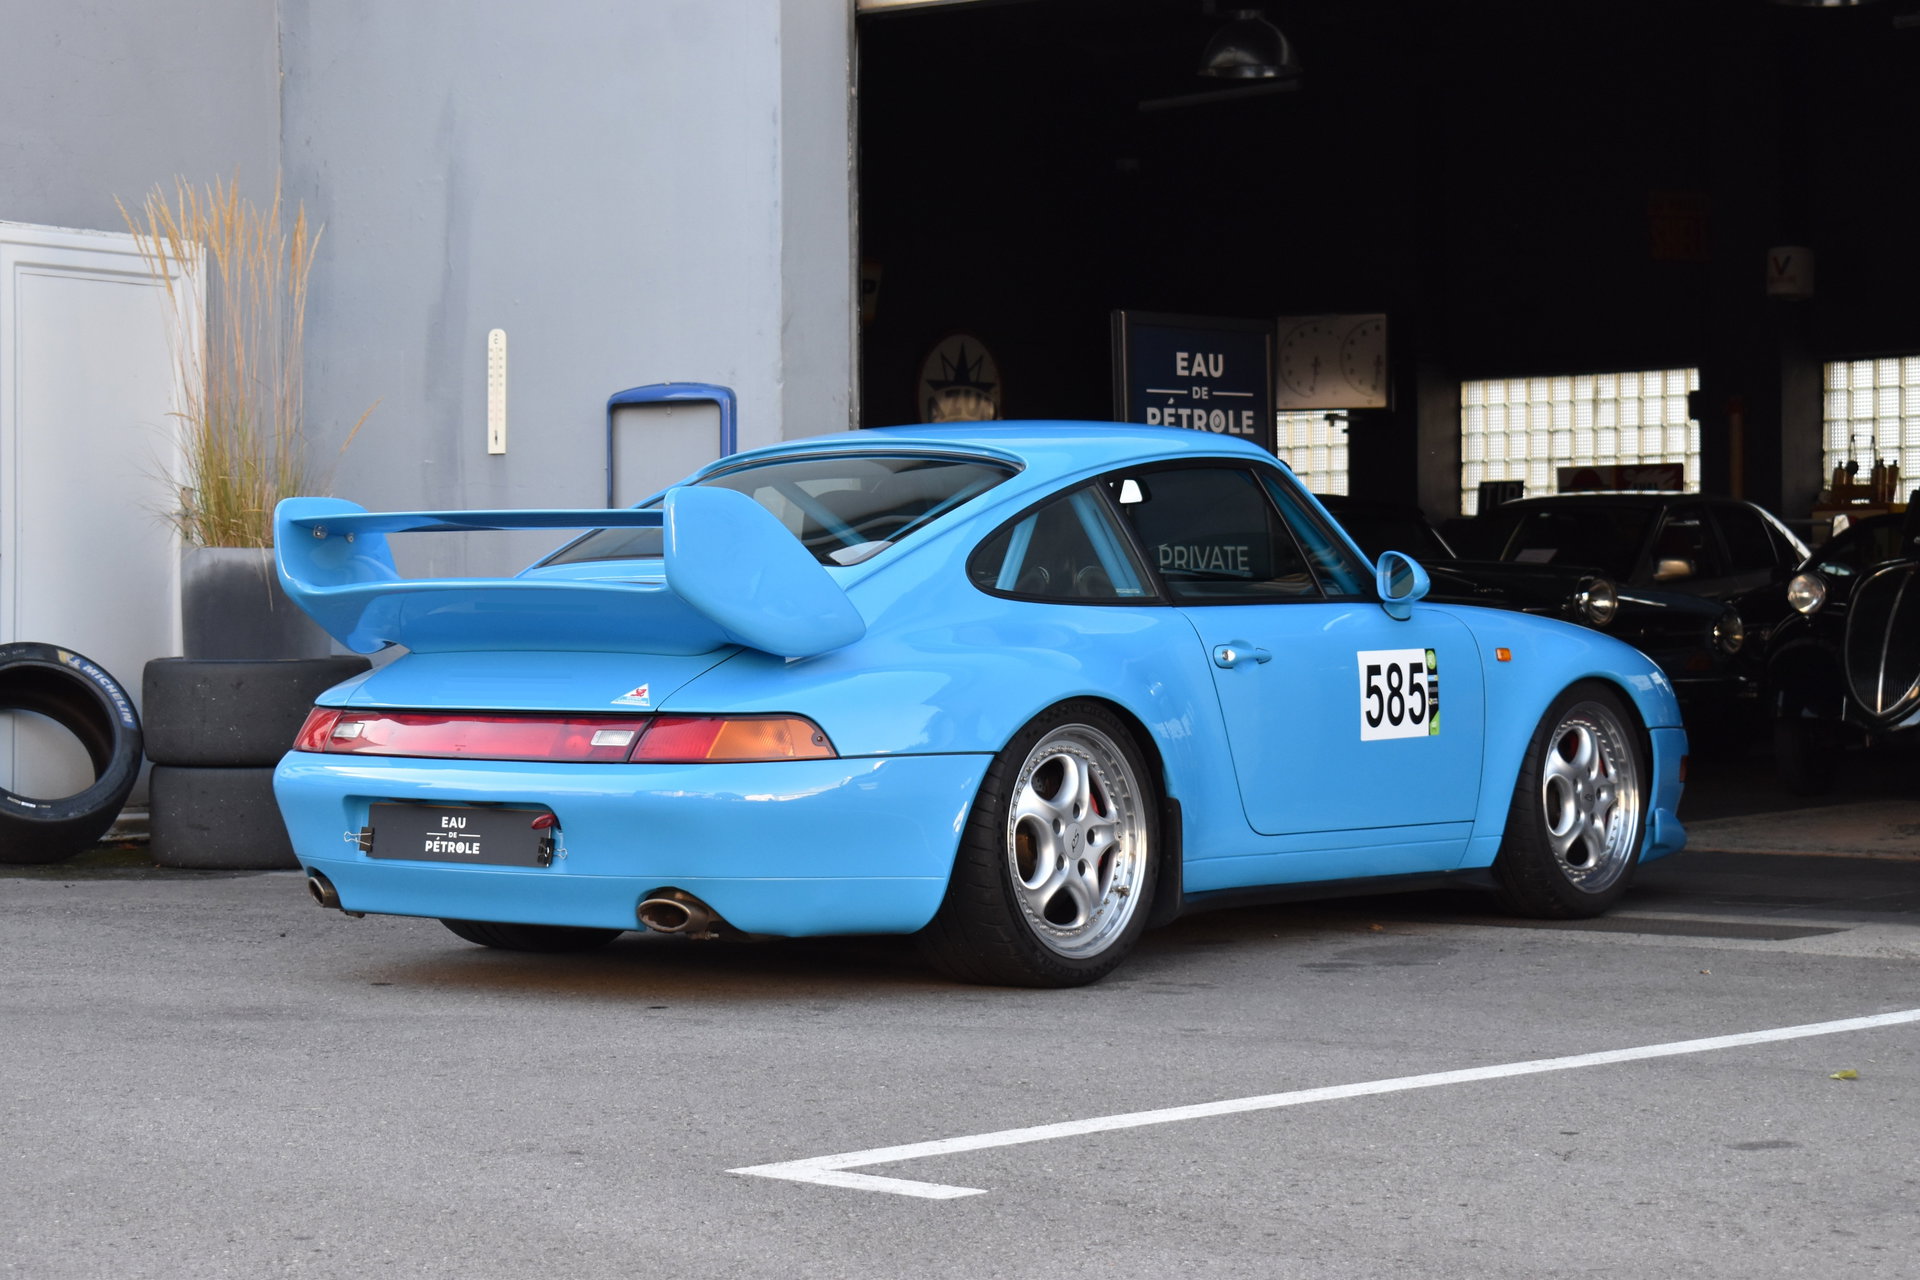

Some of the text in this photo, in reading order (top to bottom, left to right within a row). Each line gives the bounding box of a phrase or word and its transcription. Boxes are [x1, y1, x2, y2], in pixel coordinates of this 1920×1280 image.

[1175, 351, 1225, 378] EAU
[1191, 386, 1209, 400] DE
[1146, 397, 1255, 435] PÉTROLE
[1158, 543, 1250, 571] PRIVATE
[83, 665, 133, 723] MICHELIN
[1365, 662, 1427, 728] 585
[441, 816, 467, 829] EAU
[425, 836, 481, 855] PÉTROLE
